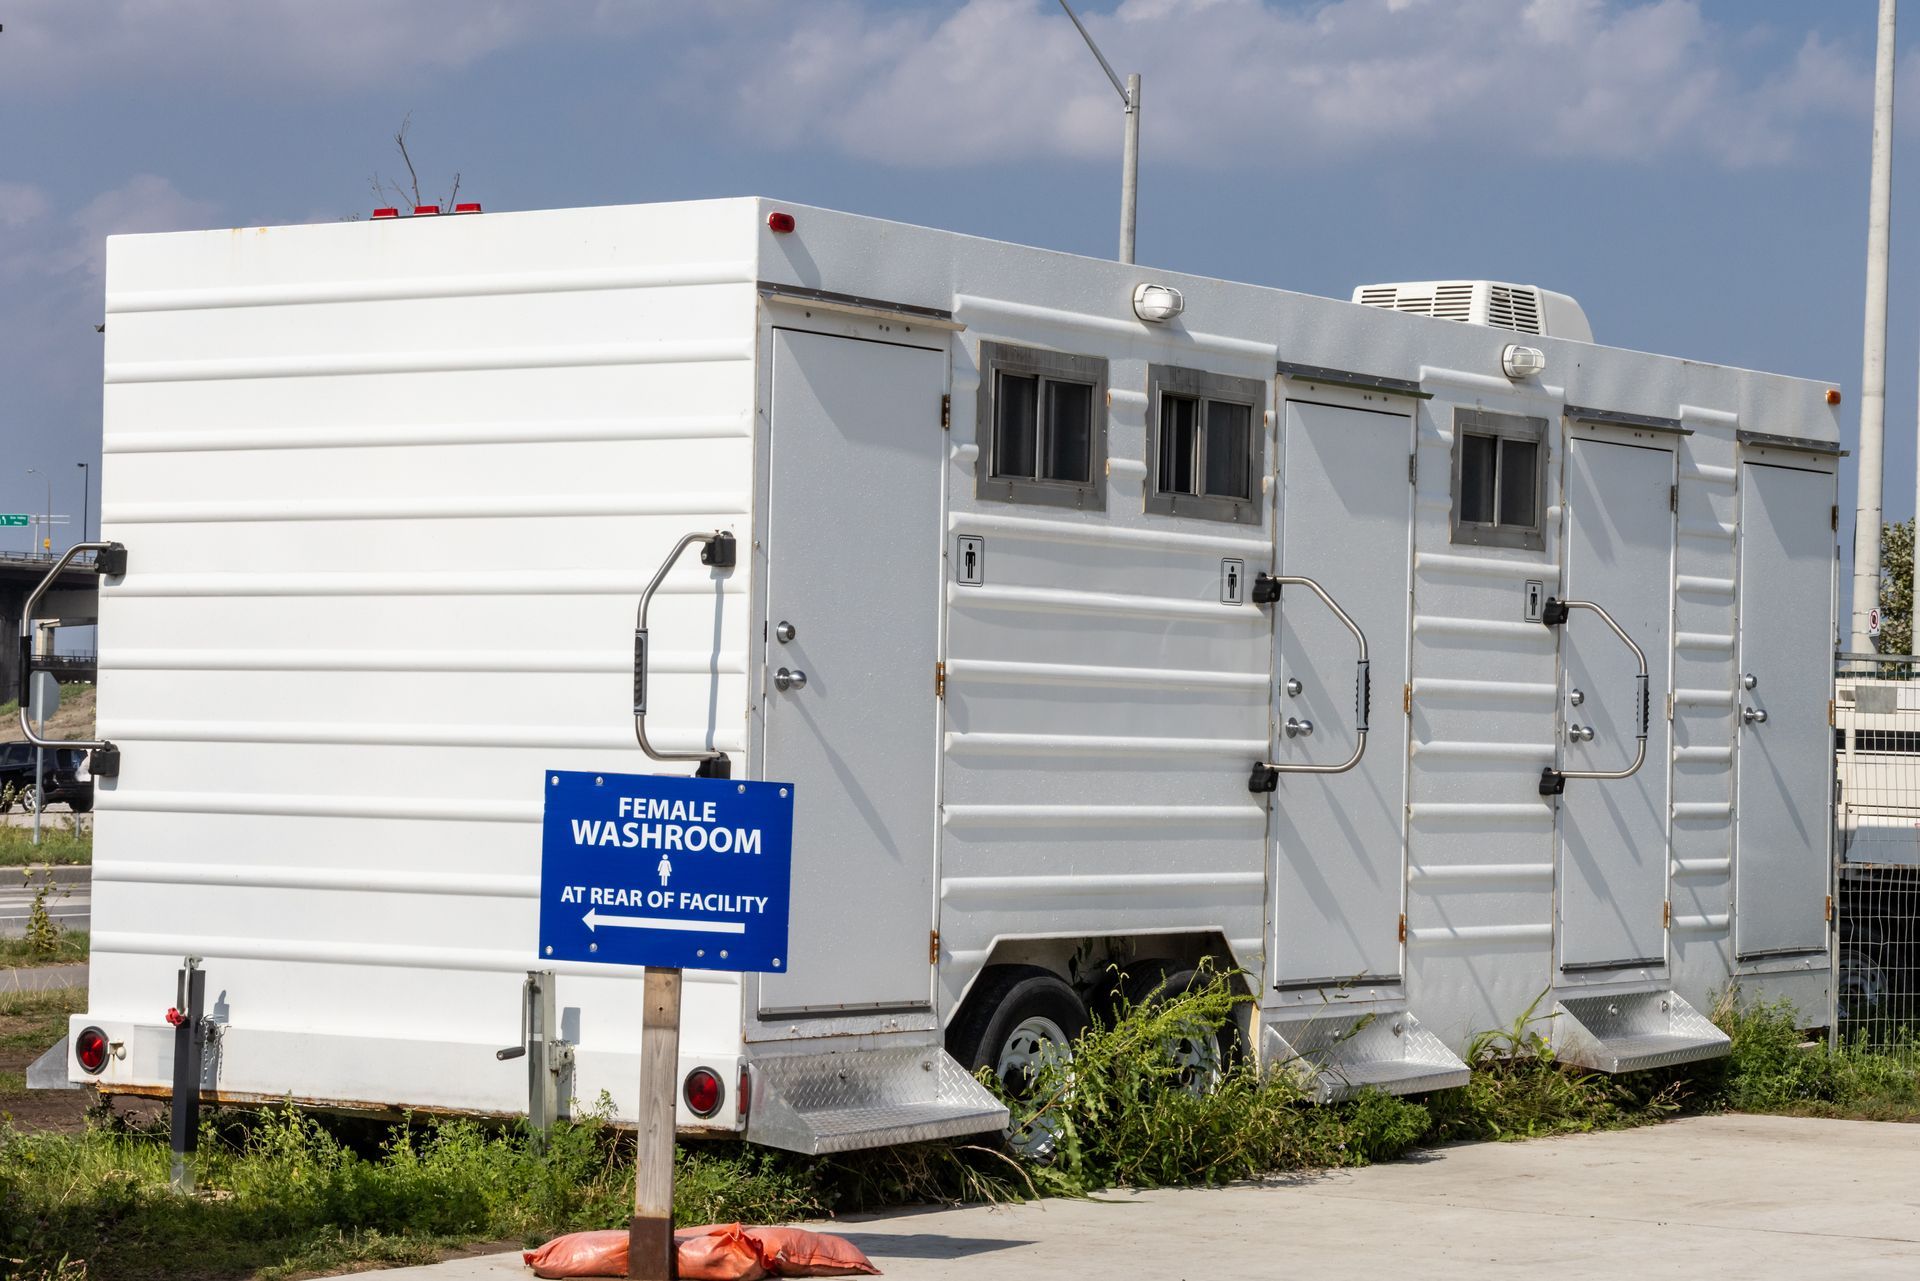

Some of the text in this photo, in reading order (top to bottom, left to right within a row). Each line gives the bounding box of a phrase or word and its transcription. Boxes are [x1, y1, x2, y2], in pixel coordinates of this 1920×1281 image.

[618, 796, 717, 823] FEMALE
[571, 819, 762, 855] WASHROOM
[560, 885, 769, 914] AT REAR OF FACILITY
